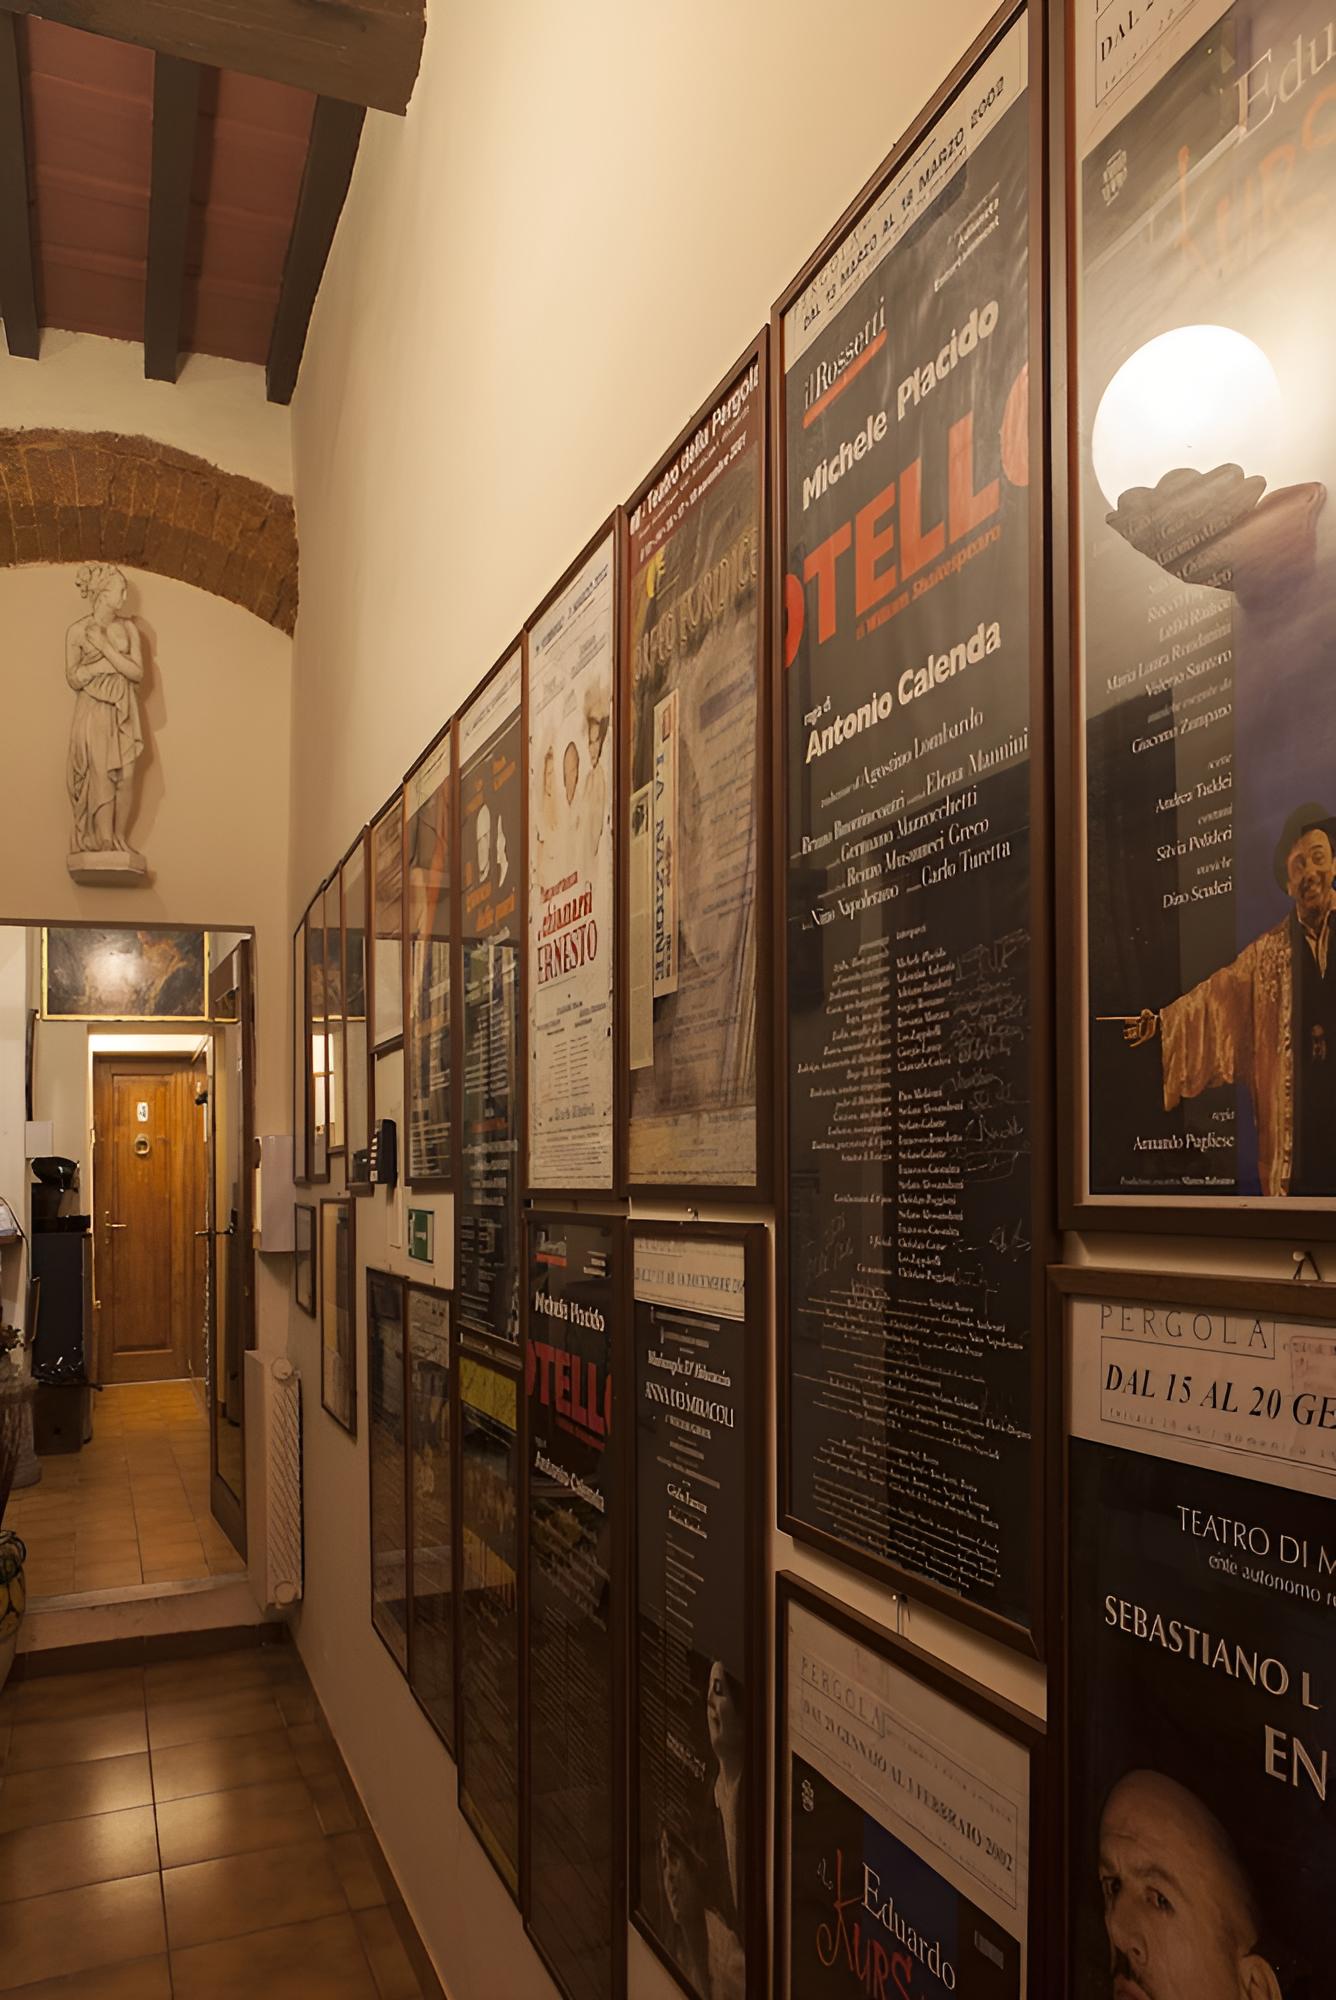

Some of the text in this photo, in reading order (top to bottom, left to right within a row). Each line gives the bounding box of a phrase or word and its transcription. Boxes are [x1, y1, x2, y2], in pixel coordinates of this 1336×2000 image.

[918, 127, 965, 192] MARZO
[970, 76, 1004, 129] 2002
[803, 411, 888, 511] Michele
[897, 299, 1000, 422] Placido
[805, 621, 1001, 764] Antonio Calenda
[537, 919, 598, 985] ERNESTO
[1100, 1303, 1268, 1350] PERGOLA
[1104, 1363, 1156, 1399] DAL
[1166, 1373, 1193, 1404] 15
[1199, 1380, 1239, 1414] AL
[1248, 1386, 1282, 1420] 20
[1177, 1504, 1270, 1556] TEATRO
[1280, 1534, 1308, 1569] DI
[1242, 1566, 1321, 1603] autonomo
[1104, 1594, 1289, 1696] SEBASTIANO
[1264, 1723, 1328, 1801] EN
[860, 1860, 956, 1991] Eduardo
